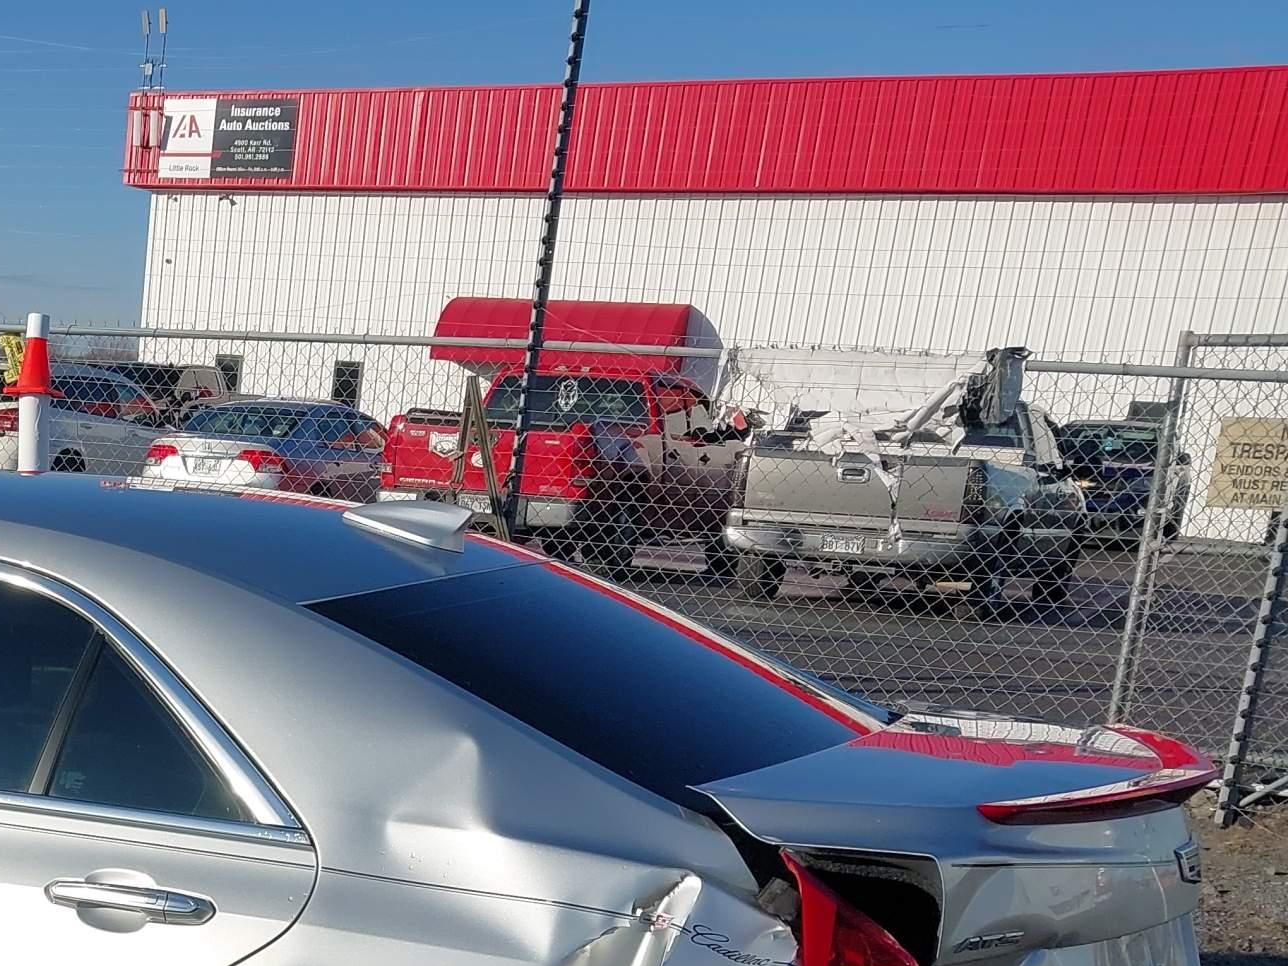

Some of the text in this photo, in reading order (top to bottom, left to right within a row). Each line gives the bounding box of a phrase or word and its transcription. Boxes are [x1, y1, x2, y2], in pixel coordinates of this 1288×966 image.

[231, 104, 281, 117] Insurance
[219, 119, 290, 131] Auto Auctions
[168, 163, 200, 172] Little Rock
[1229, 442, 1288, 461] TRESP
[1220, 463, 1281, 477] VENDORS
[1231, 479, 1268, 490] MUST
[1230, 492, 1248, 503] AT
[1249, 493, 1281, 505] MAIN
[690, 924, 771, 966] Cadillac
